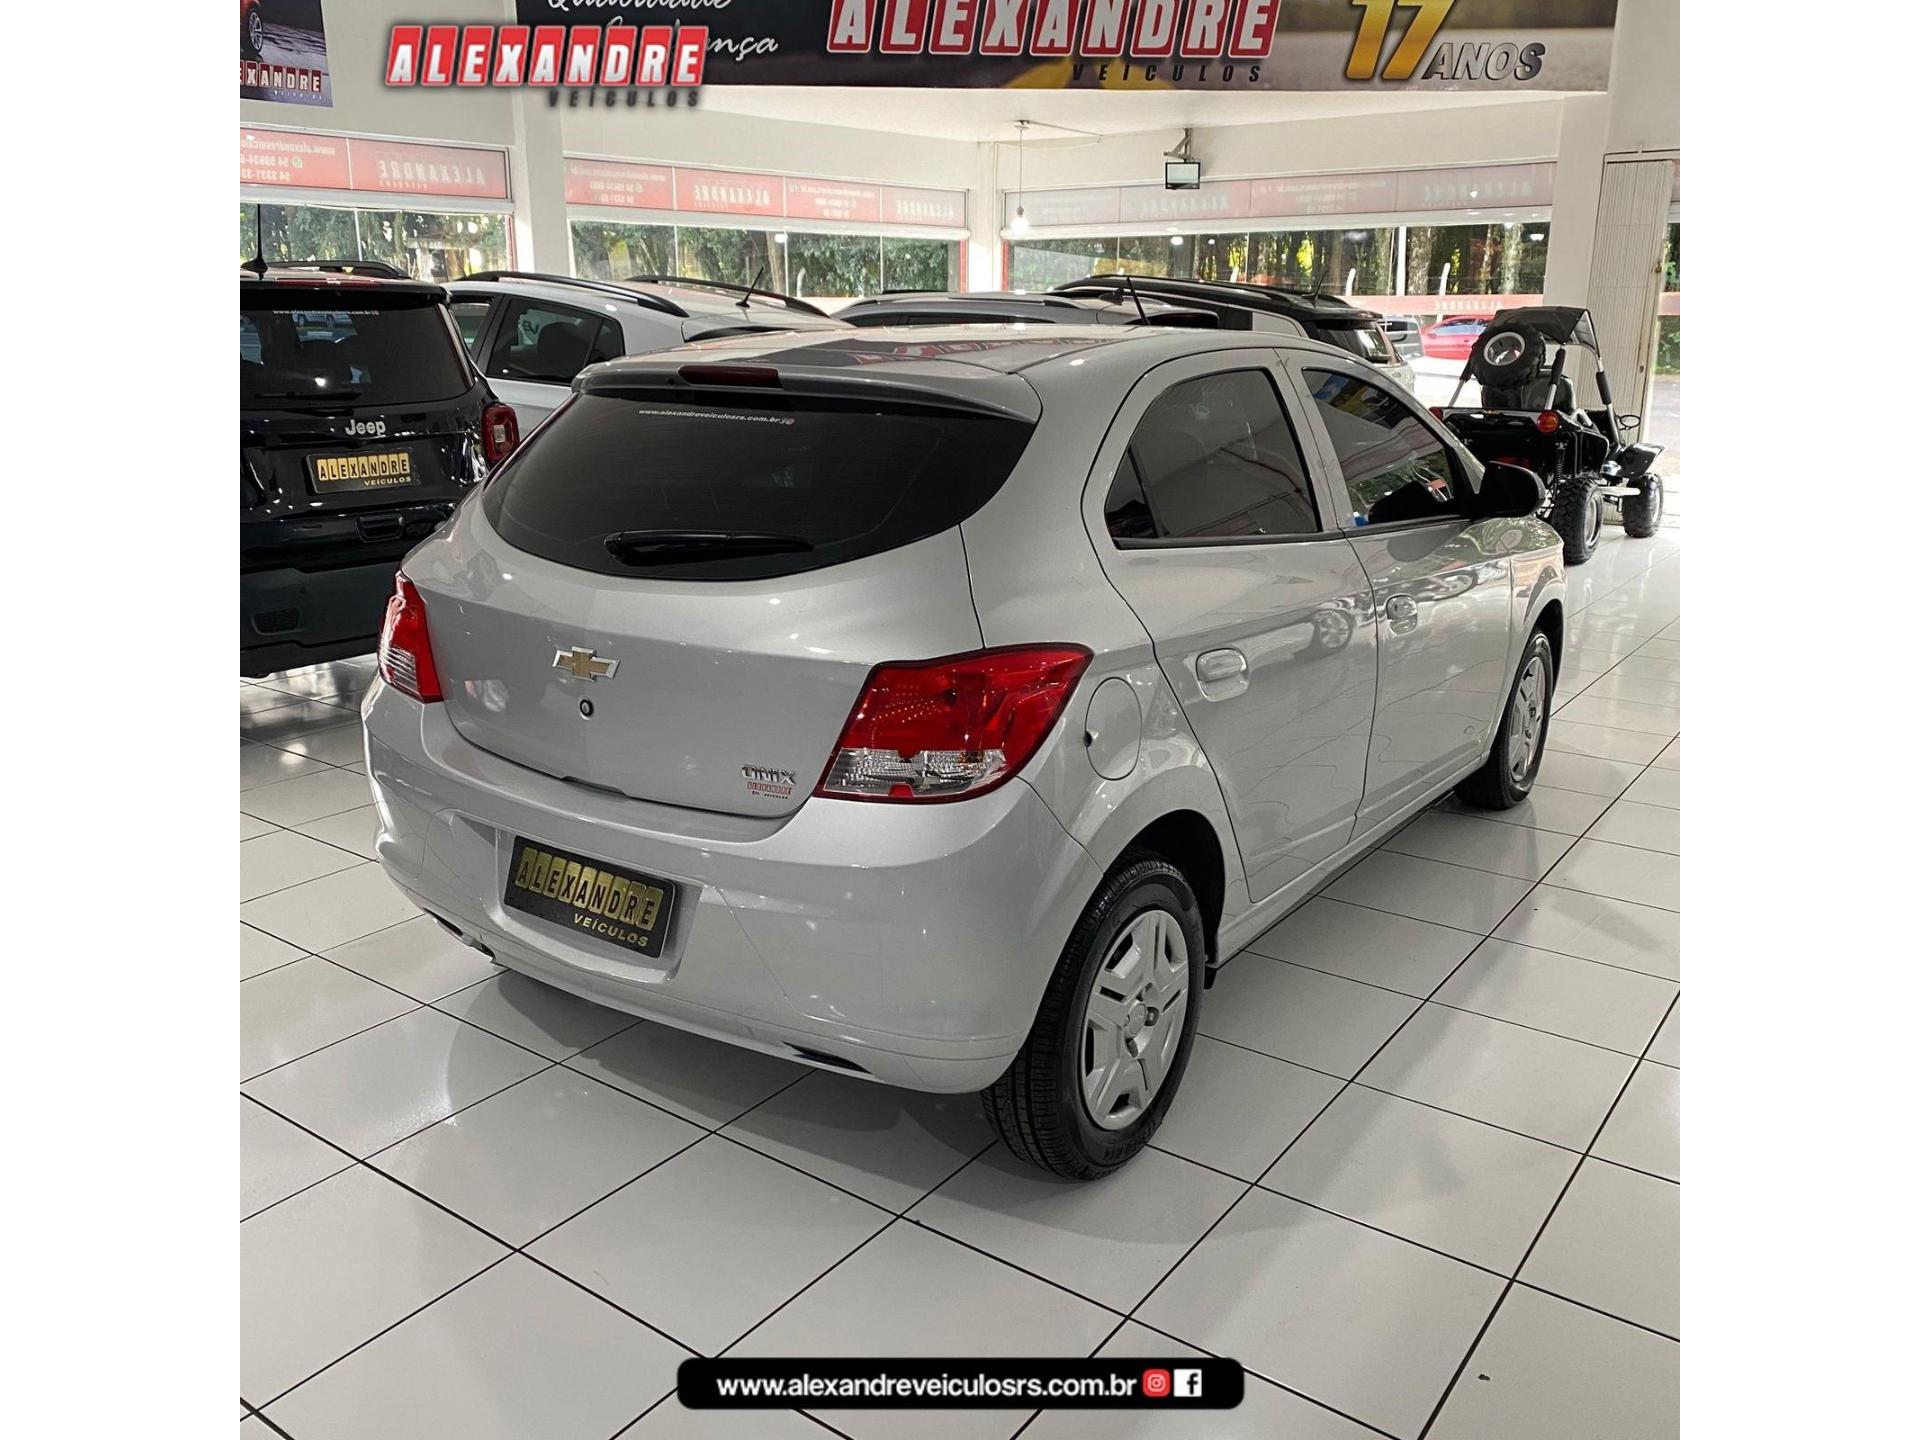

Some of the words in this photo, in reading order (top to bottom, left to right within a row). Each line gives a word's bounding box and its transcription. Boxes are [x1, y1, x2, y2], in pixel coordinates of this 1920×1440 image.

[833, 0, 1274, 49] ALEXANDRE
[1345, 0, 1454, 80] 17
[1421, 42, 1546, 81] ANOS
[240, 66, 320, 92] XANDRE
[345, 419, 386, 436] Jeep
[318, 458, 409, 481] ALEXANDRE
[516, 858, 657, 927] ALEXANDRE
[573, 912, 649, 948] VEÍCULOS
